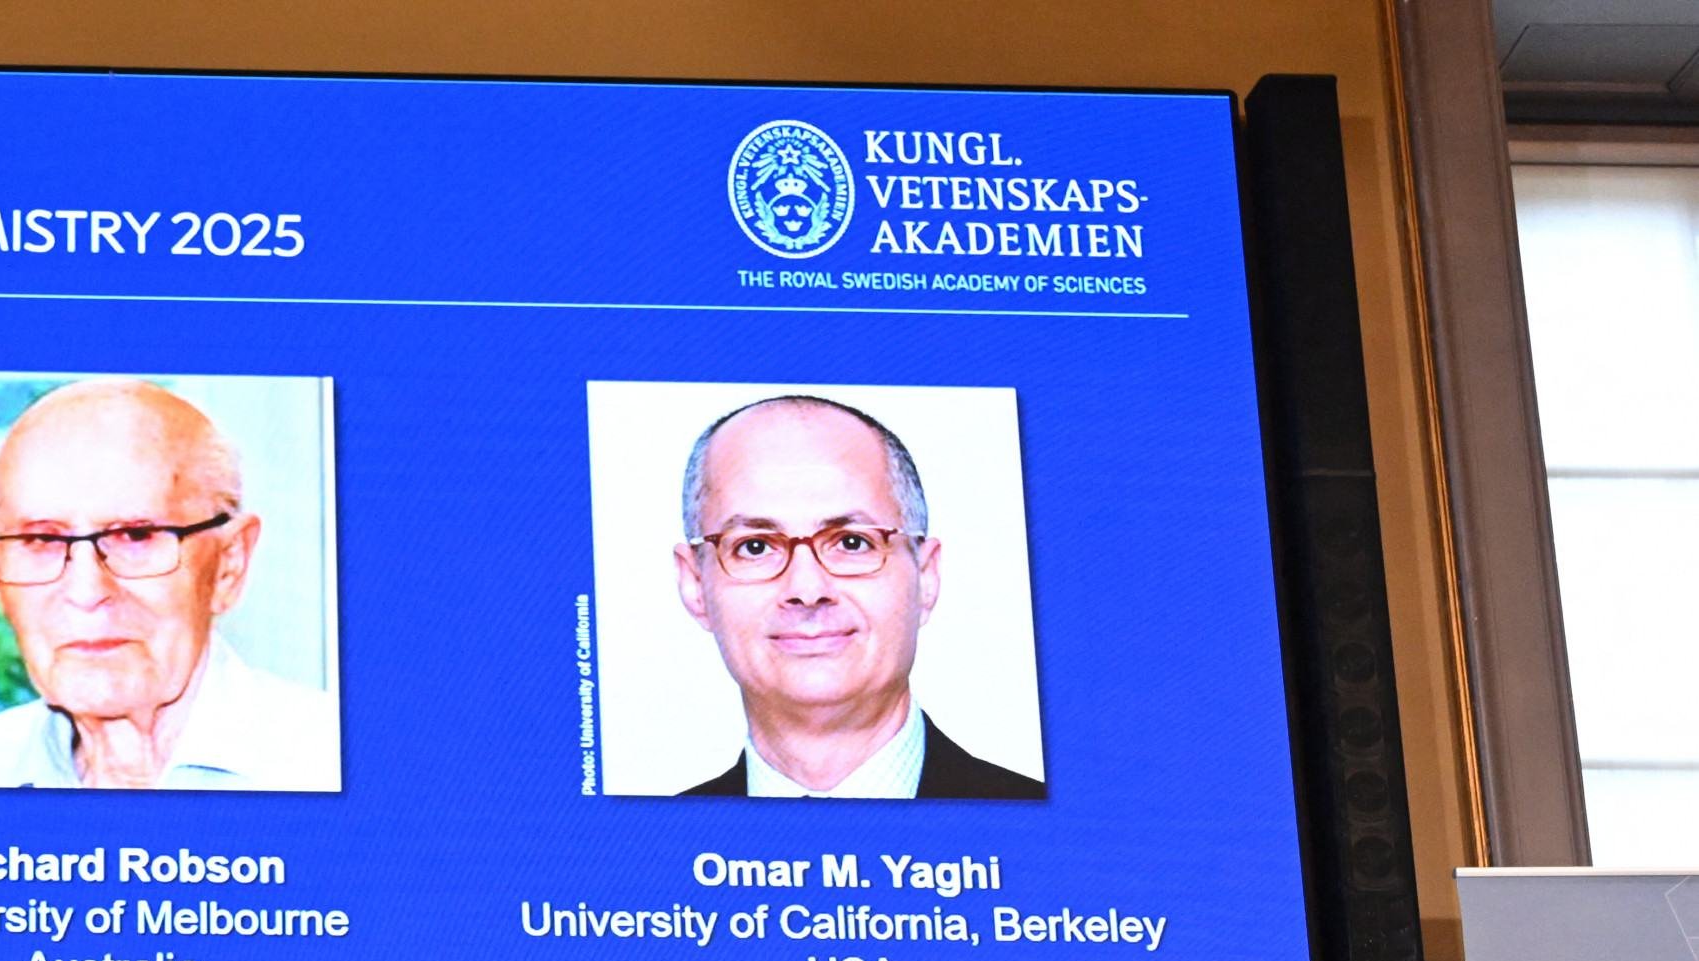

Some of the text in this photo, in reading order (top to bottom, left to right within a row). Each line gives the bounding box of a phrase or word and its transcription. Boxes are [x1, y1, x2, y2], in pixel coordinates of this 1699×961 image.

[864, 131, 1022, 165] KUNGL.
[866, 176, 1148, 213] VETENSKAPS-
[171, 212, 304, 257] 2025
[871, 220, 1142, 257] AKADEMIEN
[738, 271, 1146, 294] THE ROYAL SWEDISH ACADEMY OF SCIENCES
[574, 594, 597, 796] Photo: University of California
[120, 848, 284, 883] Robson
[693, 853, 1000, 897] Omar M. Yaghi
[86, 900, 126, 933] of
[138, 900, 349, 936] Melbourne
[522, 902, 1166, 951] University of California, Berkeley
